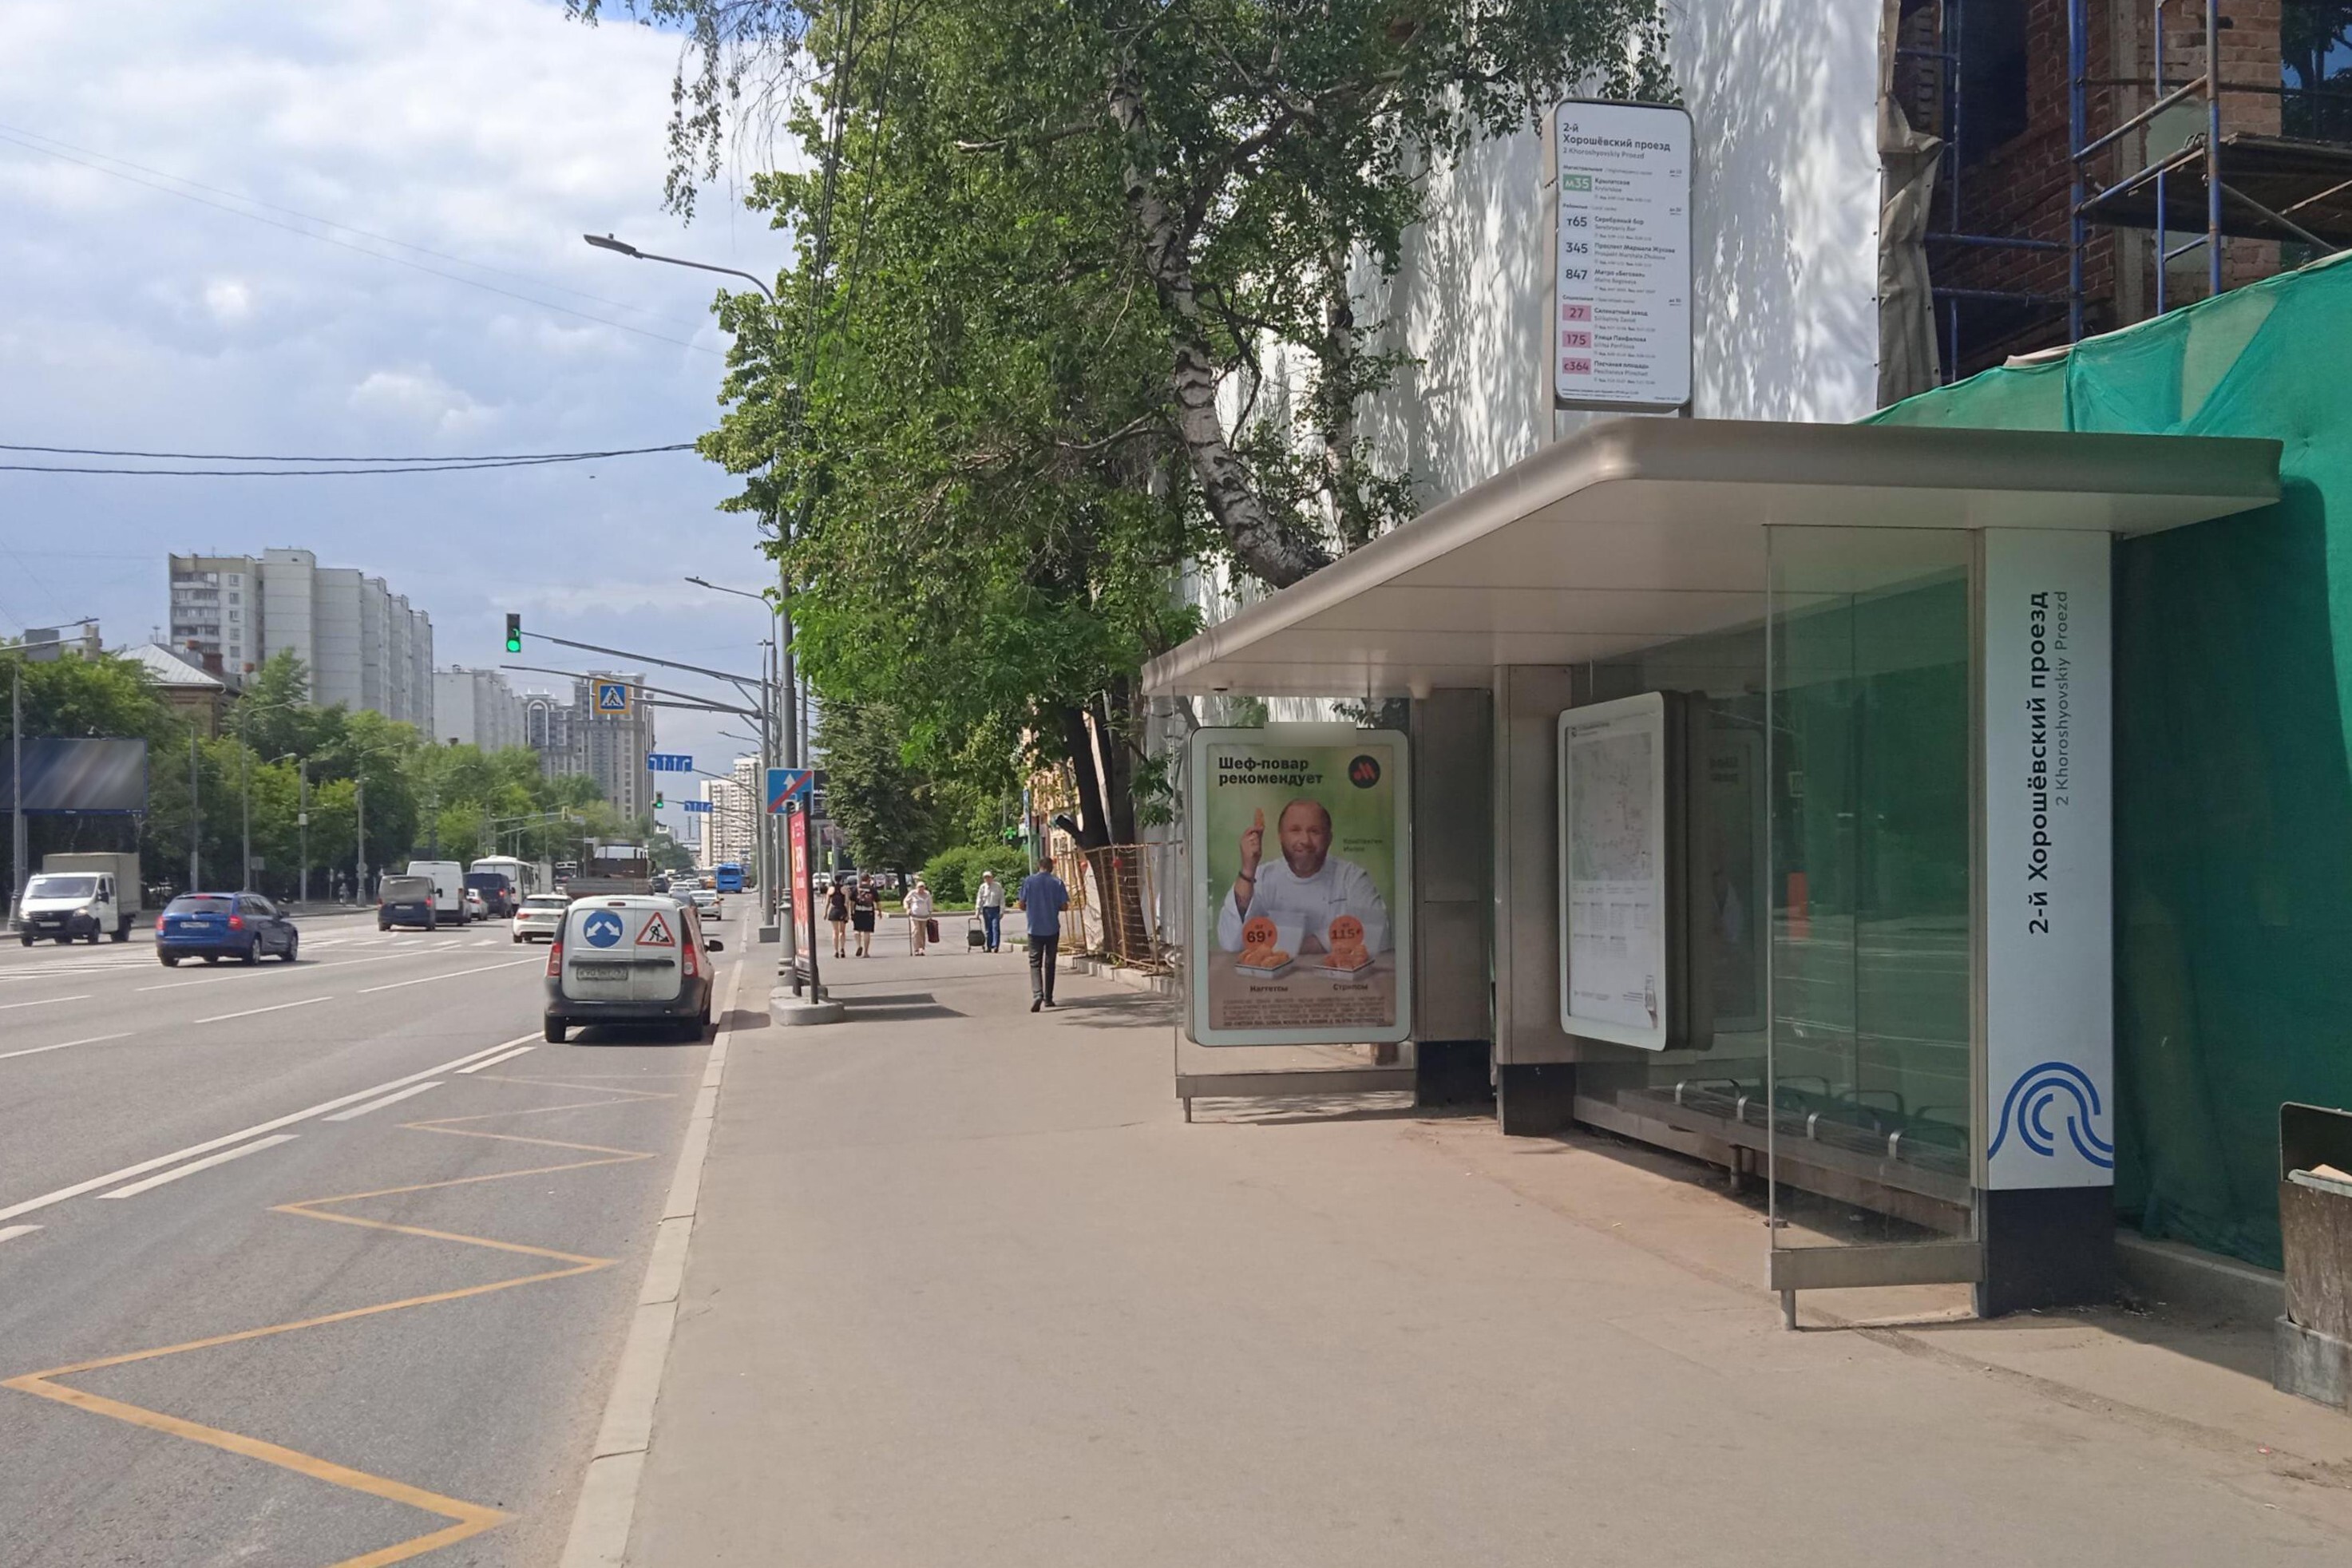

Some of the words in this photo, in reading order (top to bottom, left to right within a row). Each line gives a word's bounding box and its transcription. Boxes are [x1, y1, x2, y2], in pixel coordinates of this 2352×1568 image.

[1563, 122, 1578, 133] 2-й
[1563, 134, 1632, 148] Хорошёвский
[1634, 141, 1670, 152] проезд
[1566, 242, 1588, 254] 345
[1566, 268, 1588, 280] 847
[1569, 307, 1585, 319] 27
[1567, 334, 1586, 346] 175
[2055, 591, 2069, 650] Proezd
[2030, 591, 2050, 689] проезд
[2055, 657, 2072, 790] Khoroshyovskiy
[1218, 756, 1309, 771] Шеф-повар
[1218, 773, 1324, 786] рекомендует
[2026, 699, 2052, 881] Хорошёвский
[2056, 795, 2069, 806] 2
[2029, 890, 2049, 935] 2-й
